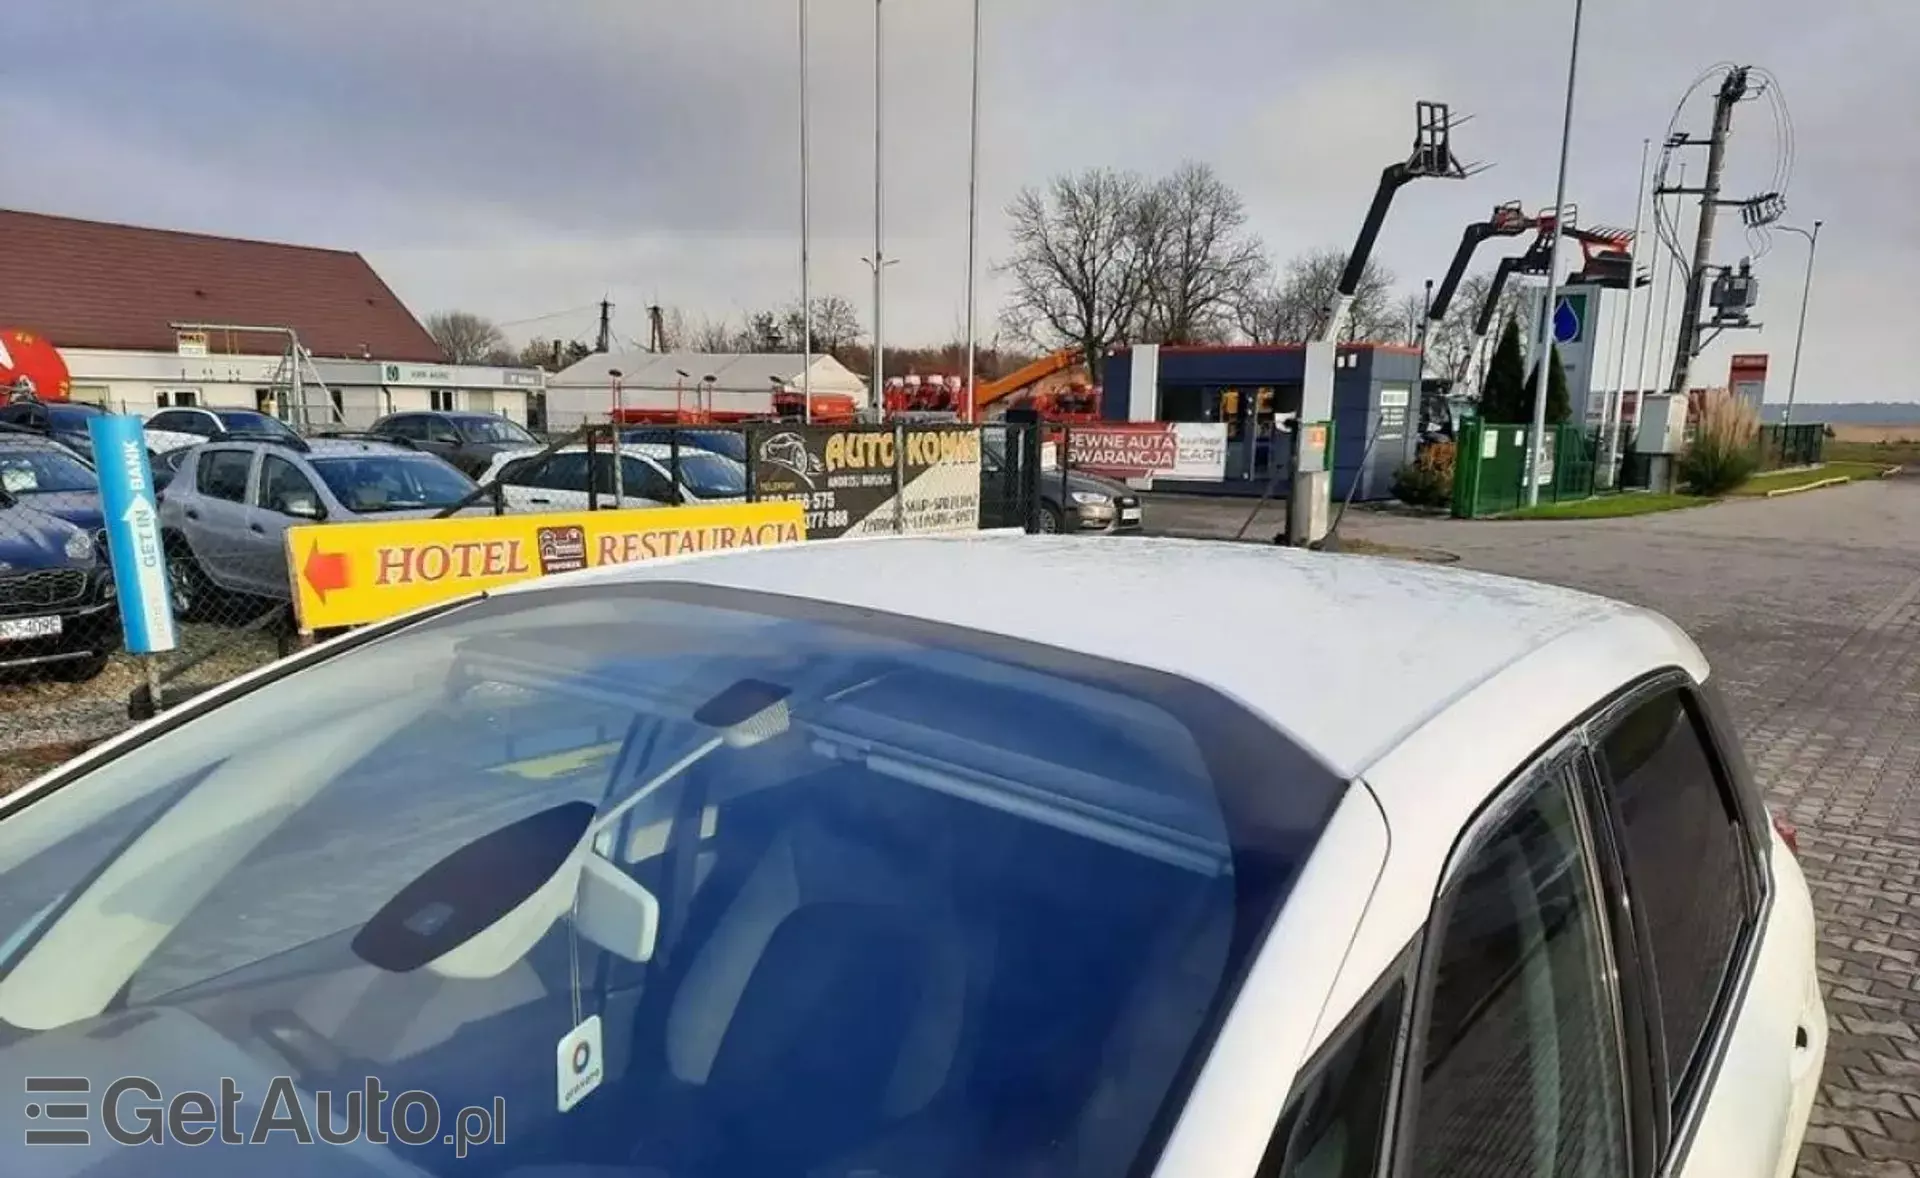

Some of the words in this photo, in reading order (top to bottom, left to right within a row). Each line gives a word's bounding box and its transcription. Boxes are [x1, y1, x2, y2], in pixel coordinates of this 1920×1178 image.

[826, 431, 894, 472] AUTO
[1127, 434, 1175, 449] AUTA
[123, 439, 145, 491] BANK
[375, 541, 529, 586] HOTEL
